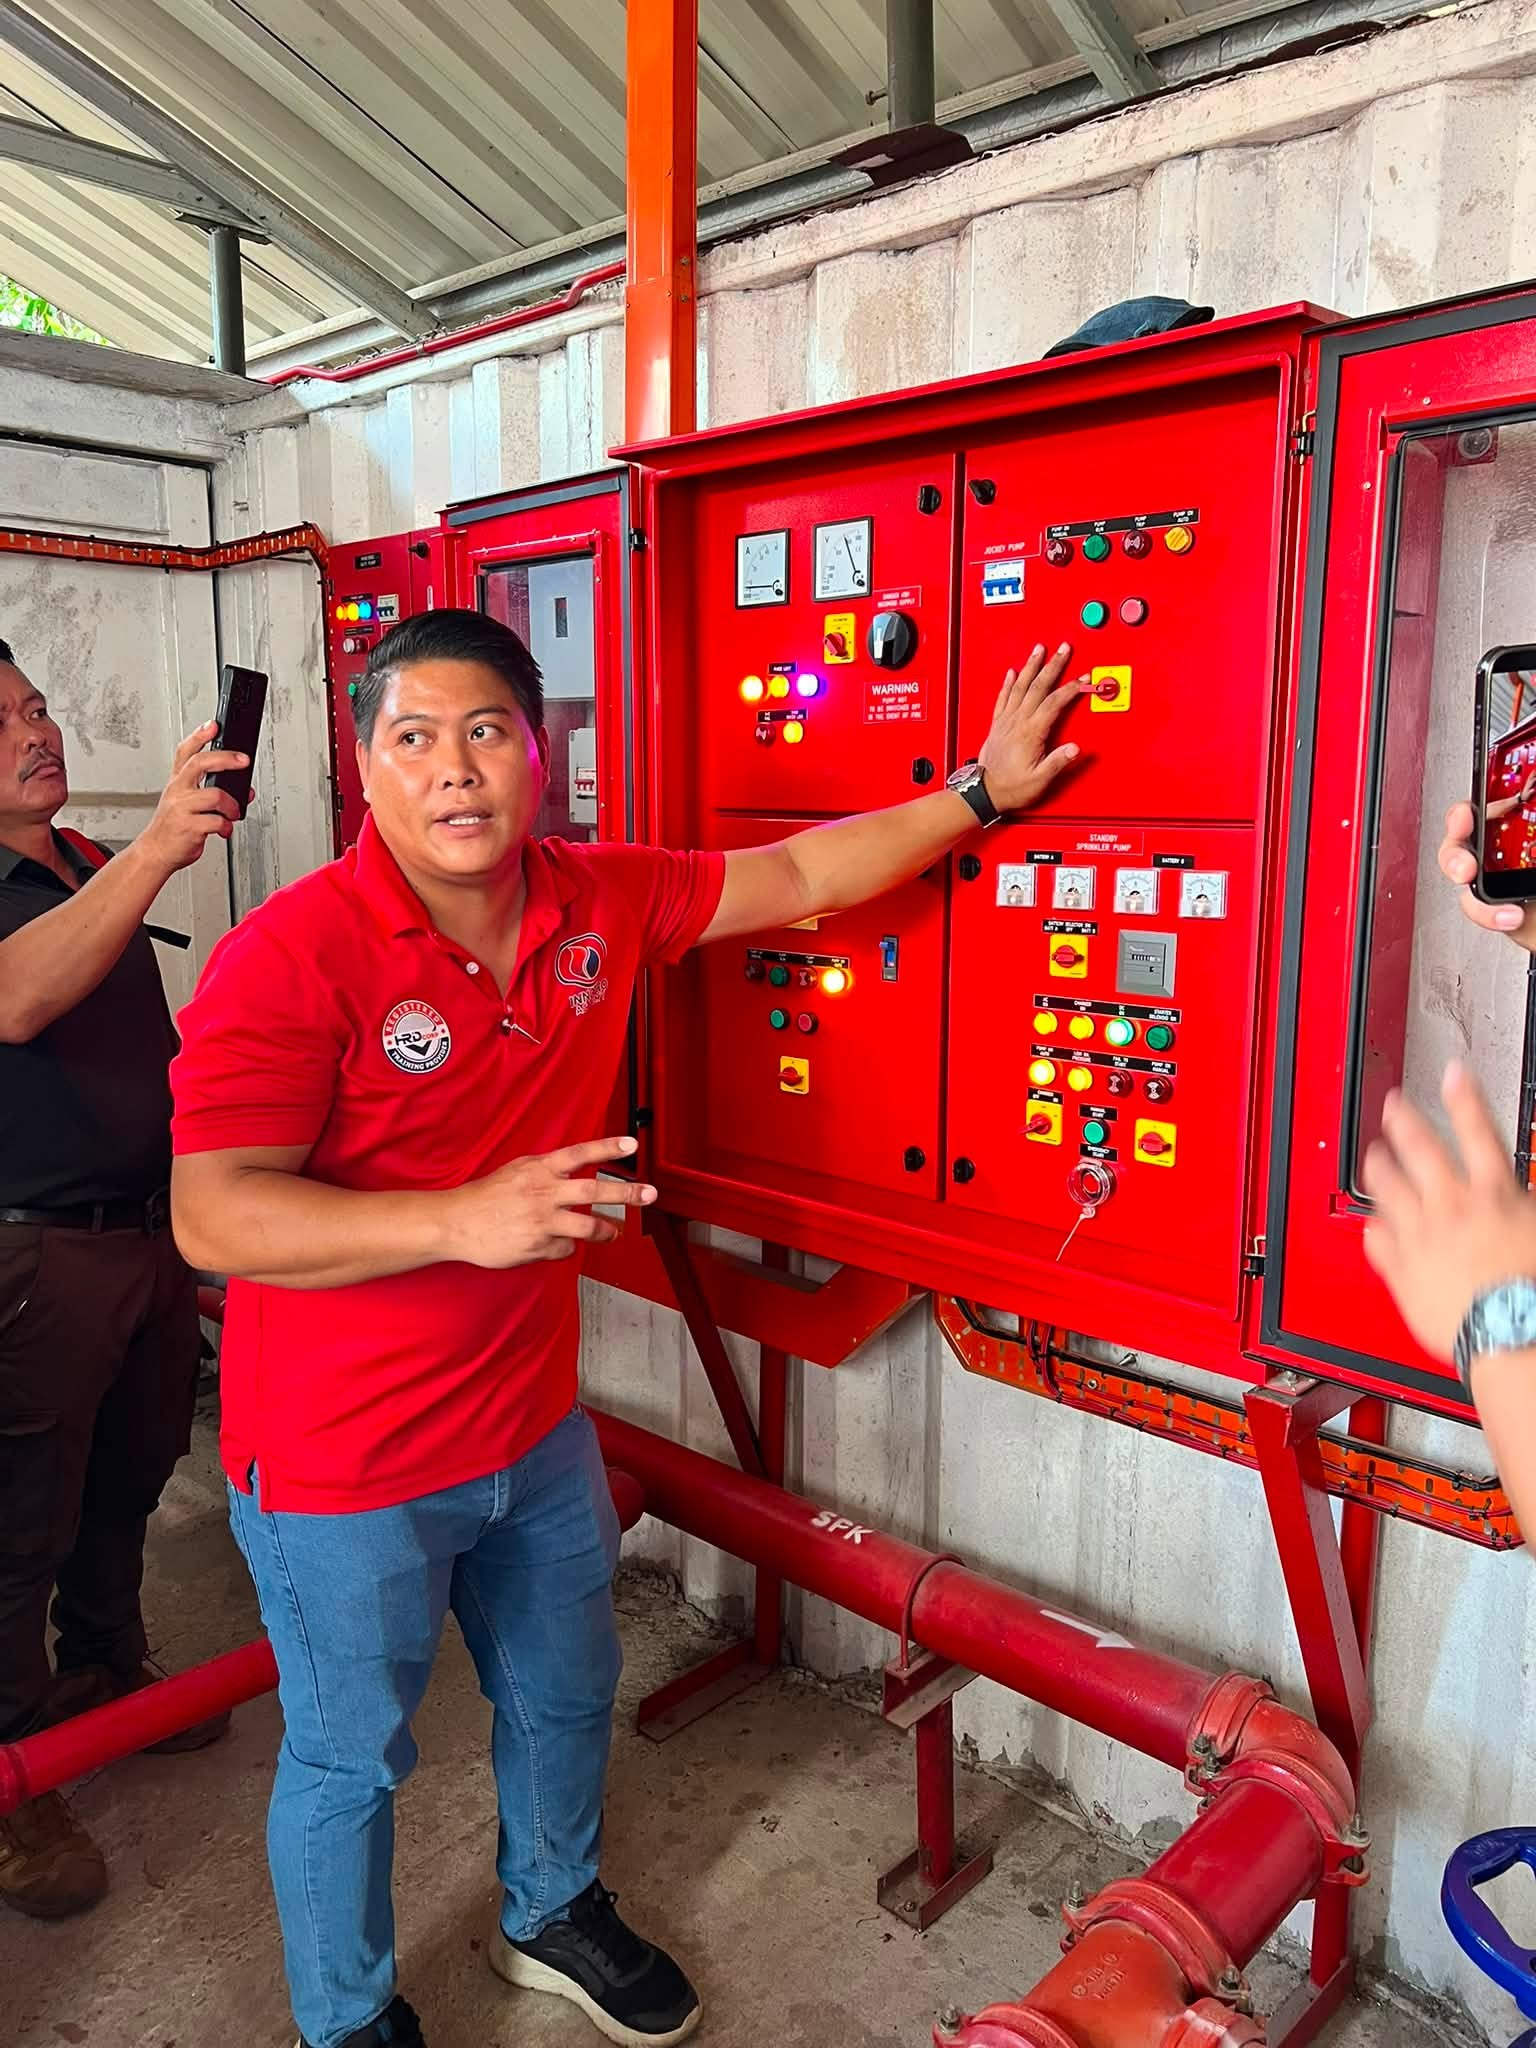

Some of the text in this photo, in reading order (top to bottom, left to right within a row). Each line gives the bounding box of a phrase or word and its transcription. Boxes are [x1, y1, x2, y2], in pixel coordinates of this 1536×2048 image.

[824, 535, 831, 543] V
[745, 546, 751, 555] A
[984, 541, 1025, 555] JOCKEY PUMP
[872, 681, 919, 696] WARNING
[1089, 833, 1118, 842] STANDBY
[1076, 843, 1132, 852] SPRINKLER PUMP
[385, 1002, 440, 1033] REGISTERED
[394, 1031, 422, 1046] HRD
[391, 1040, 448, 1070] TRAINING PROVIDER
[810, 1511, 874, 1545] SPK
